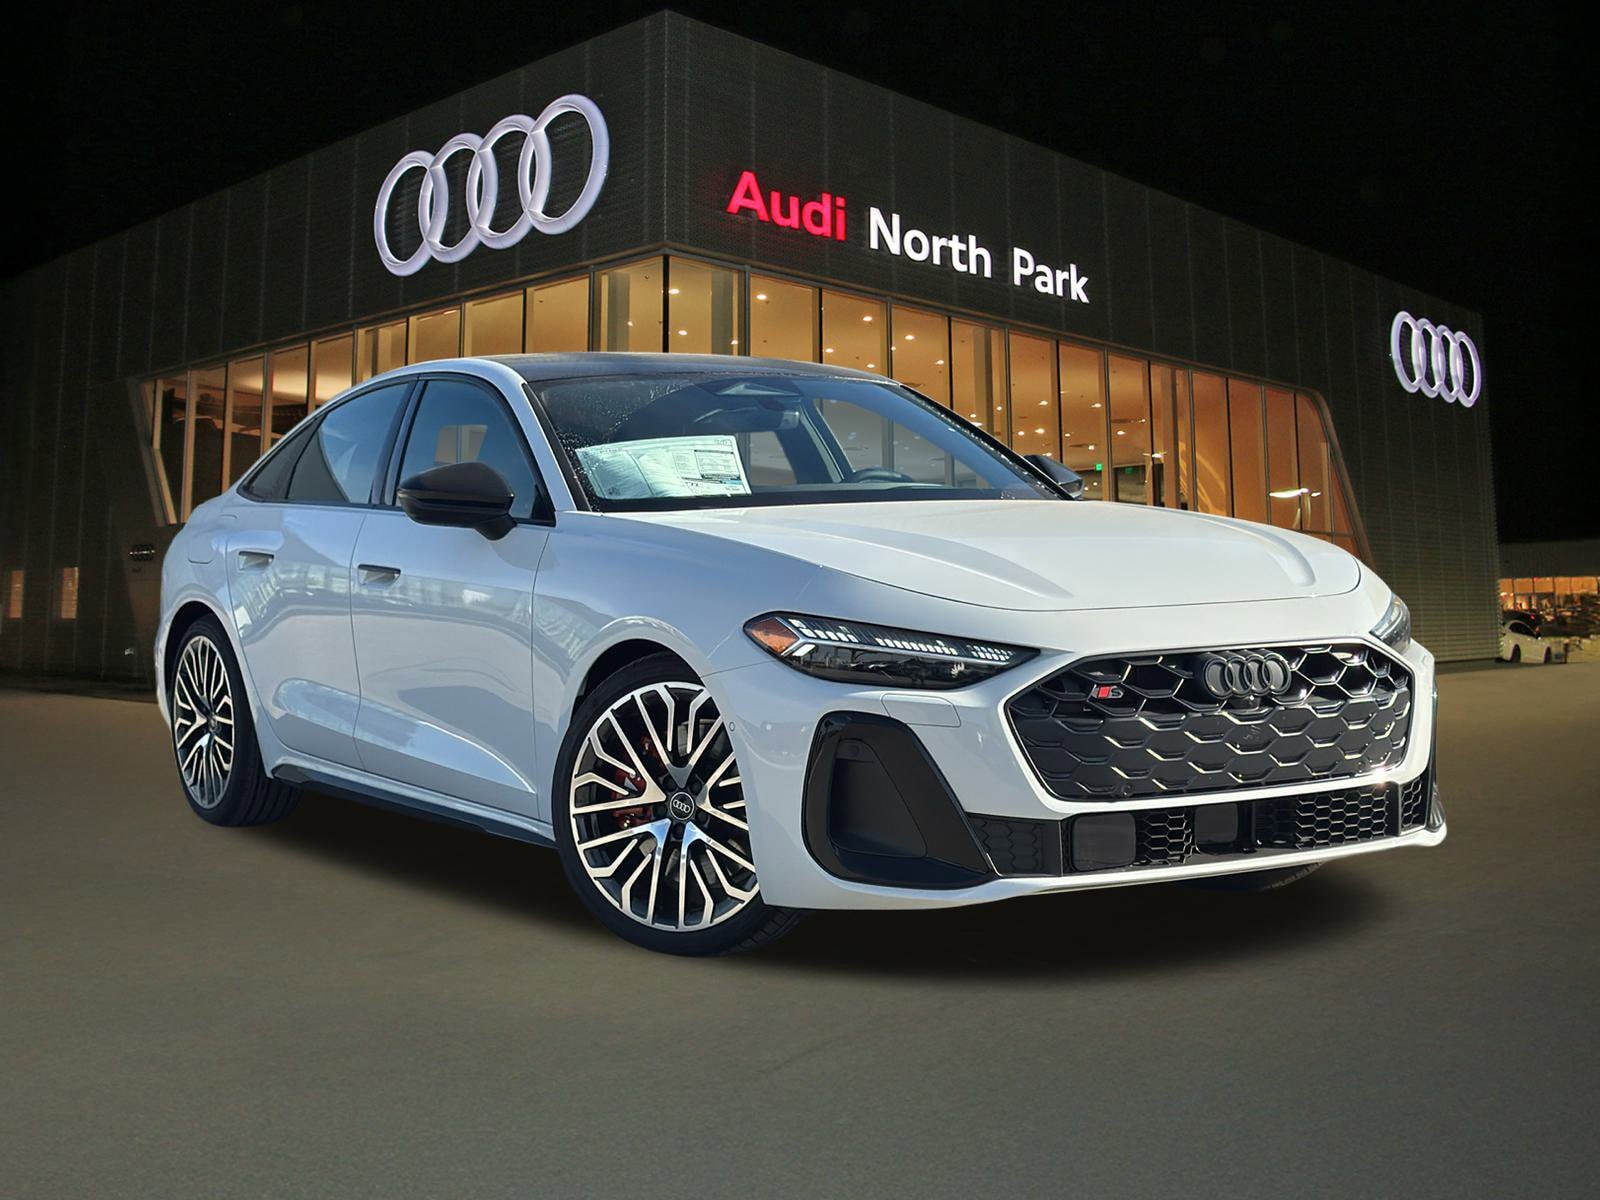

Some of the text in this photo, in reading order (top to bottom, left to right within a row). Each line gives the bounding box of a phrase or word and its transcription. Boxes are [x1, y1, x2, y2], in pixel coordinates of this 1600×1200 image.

[726, 171, 1090, 304] Audi North Park
